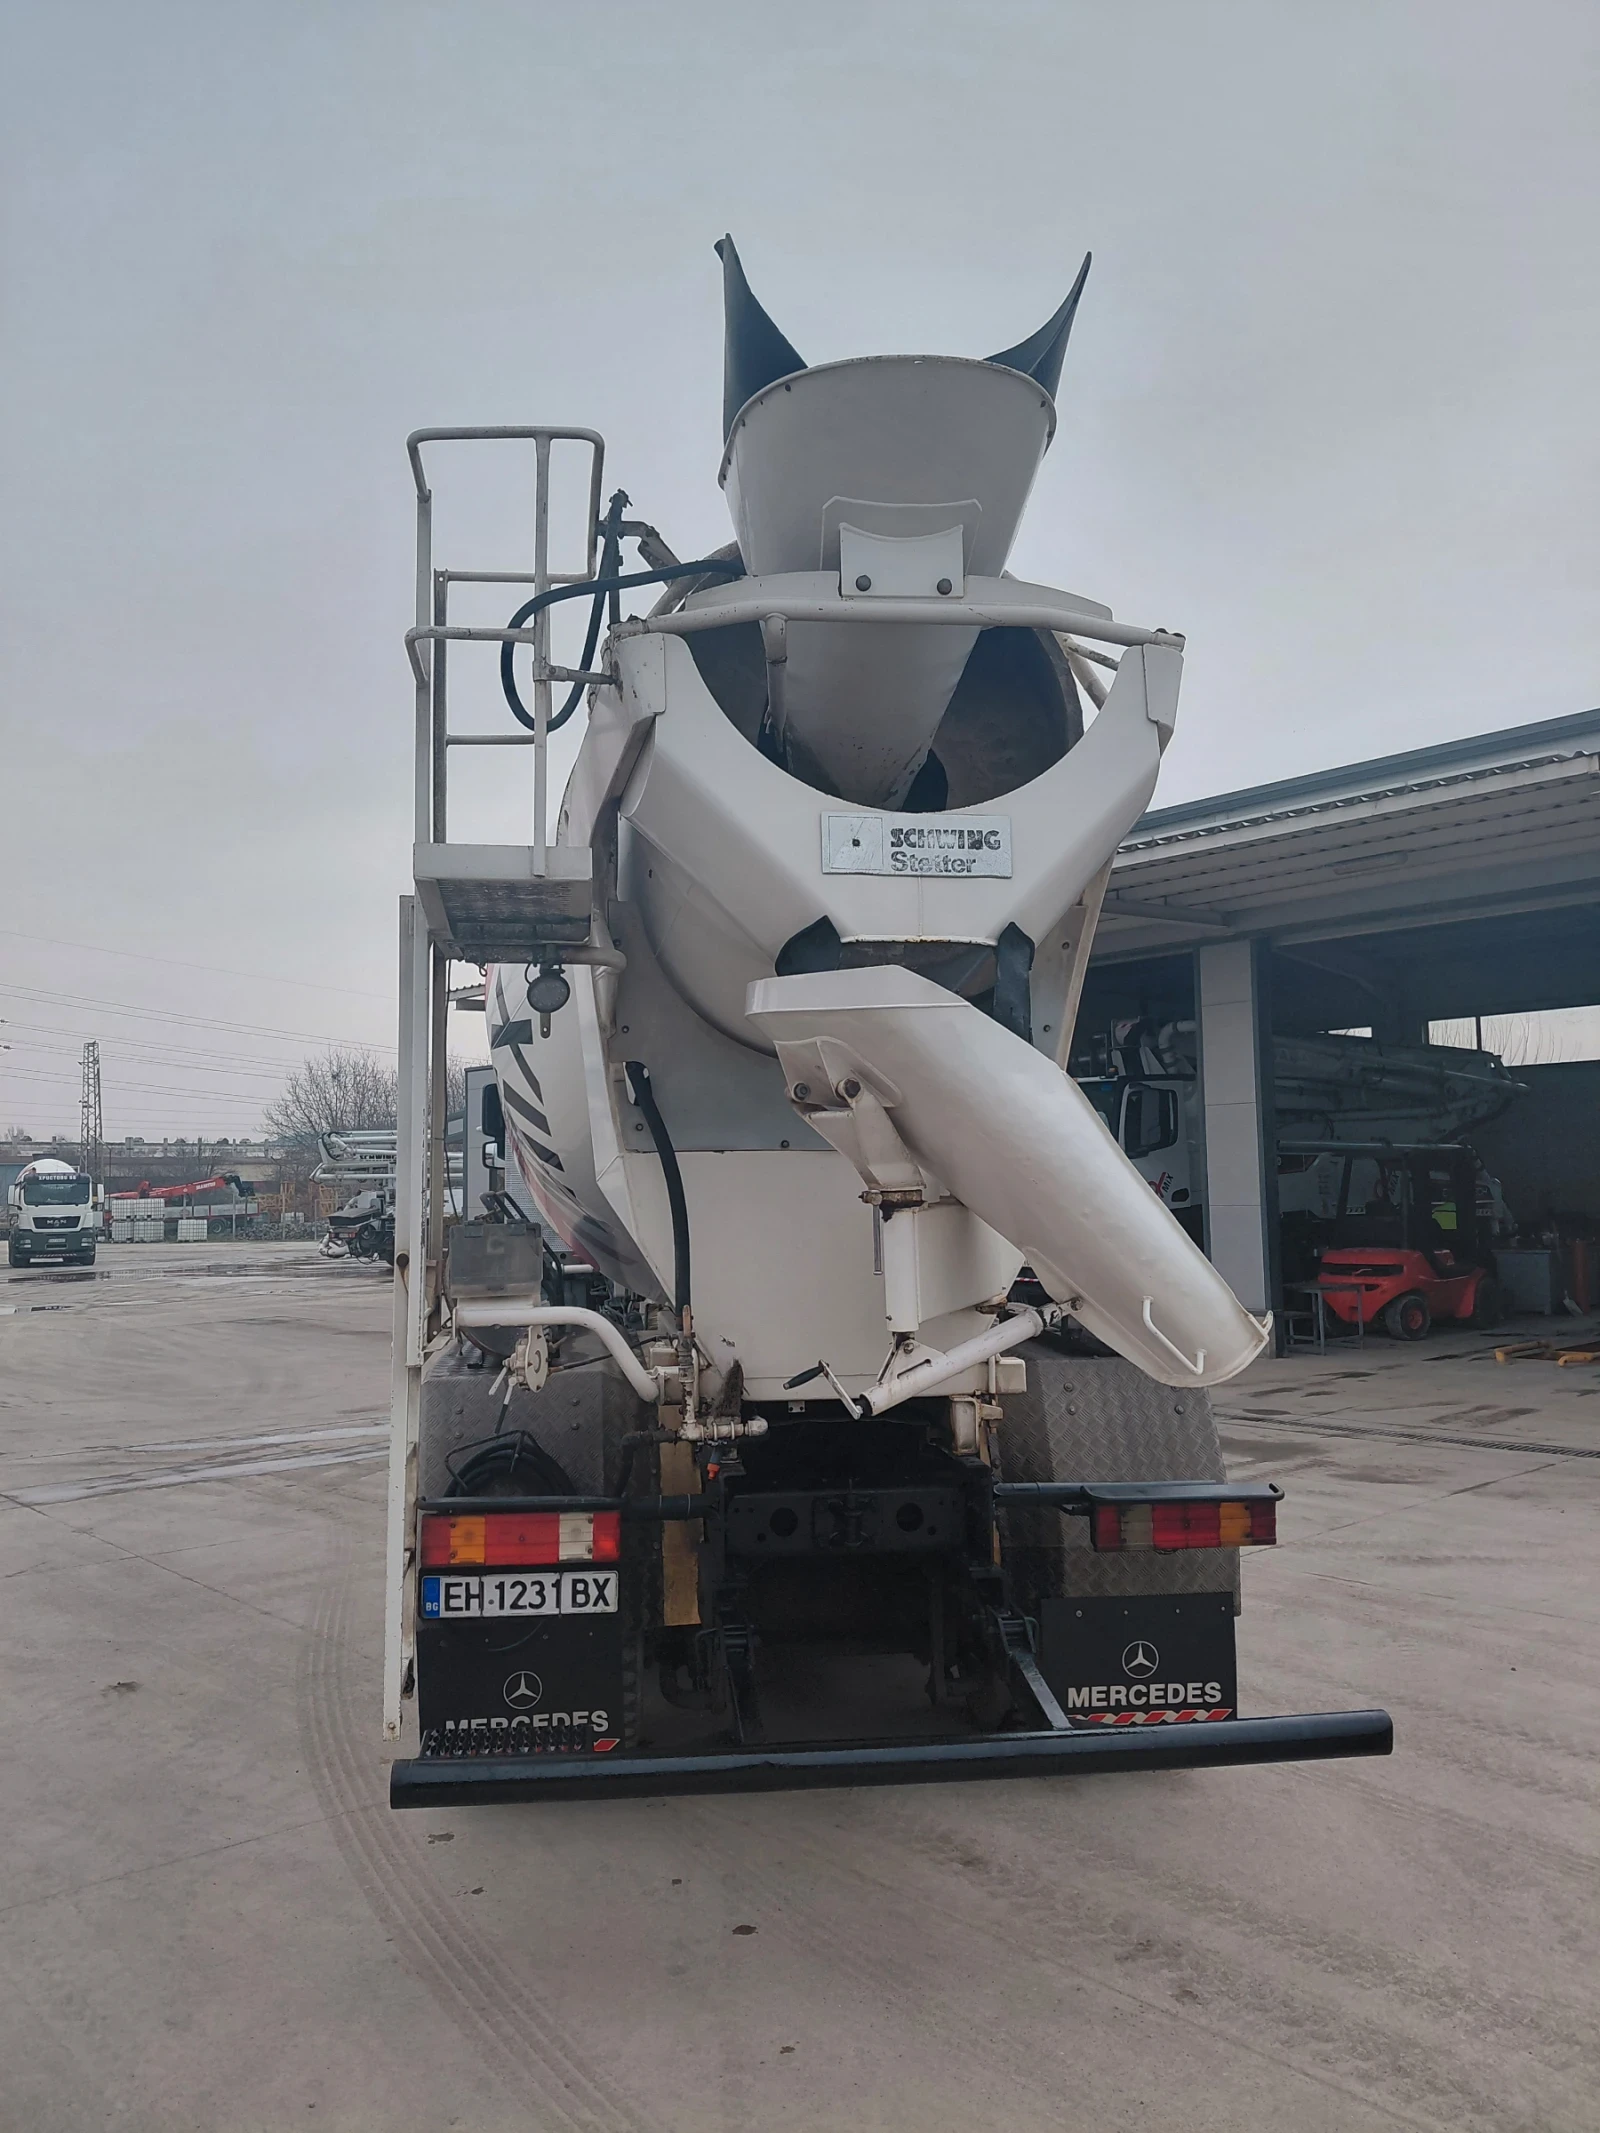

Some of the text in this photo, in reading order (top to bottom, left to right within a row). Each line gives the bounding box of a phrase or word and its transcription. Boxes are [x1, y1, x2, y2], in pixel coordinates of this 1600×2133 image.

[890, 828, 1001, 850] SCHWING
[1162, 1172, 1173, 1192] MIX
[494, 1578, 560, 1611] 1231
[571, 1577, 612, 1608] BX
[425, 1601, 439, 1611] BG
[1067, 1681, 1222, 1708] MERCEDES
